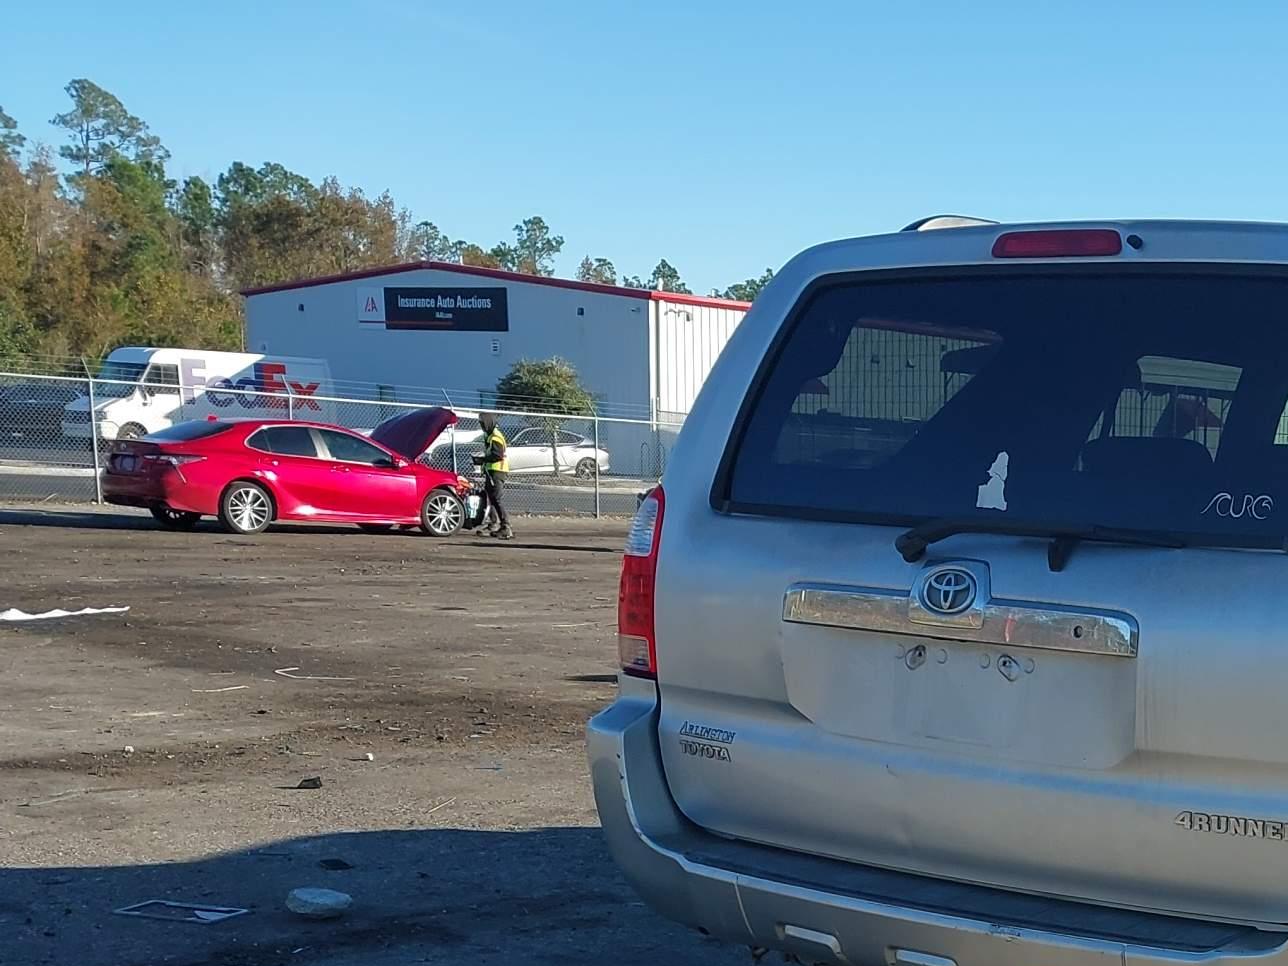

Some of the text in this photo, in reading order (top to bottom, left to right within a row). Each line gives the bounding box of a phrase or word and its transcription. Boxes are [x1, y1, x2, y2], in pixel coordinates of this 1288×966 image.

[397, 295, 492, 309] Insurance Auto Auctions
[181, 358, 322, 411] FedEx
[680, 740, 732, 763] TOYOTA
